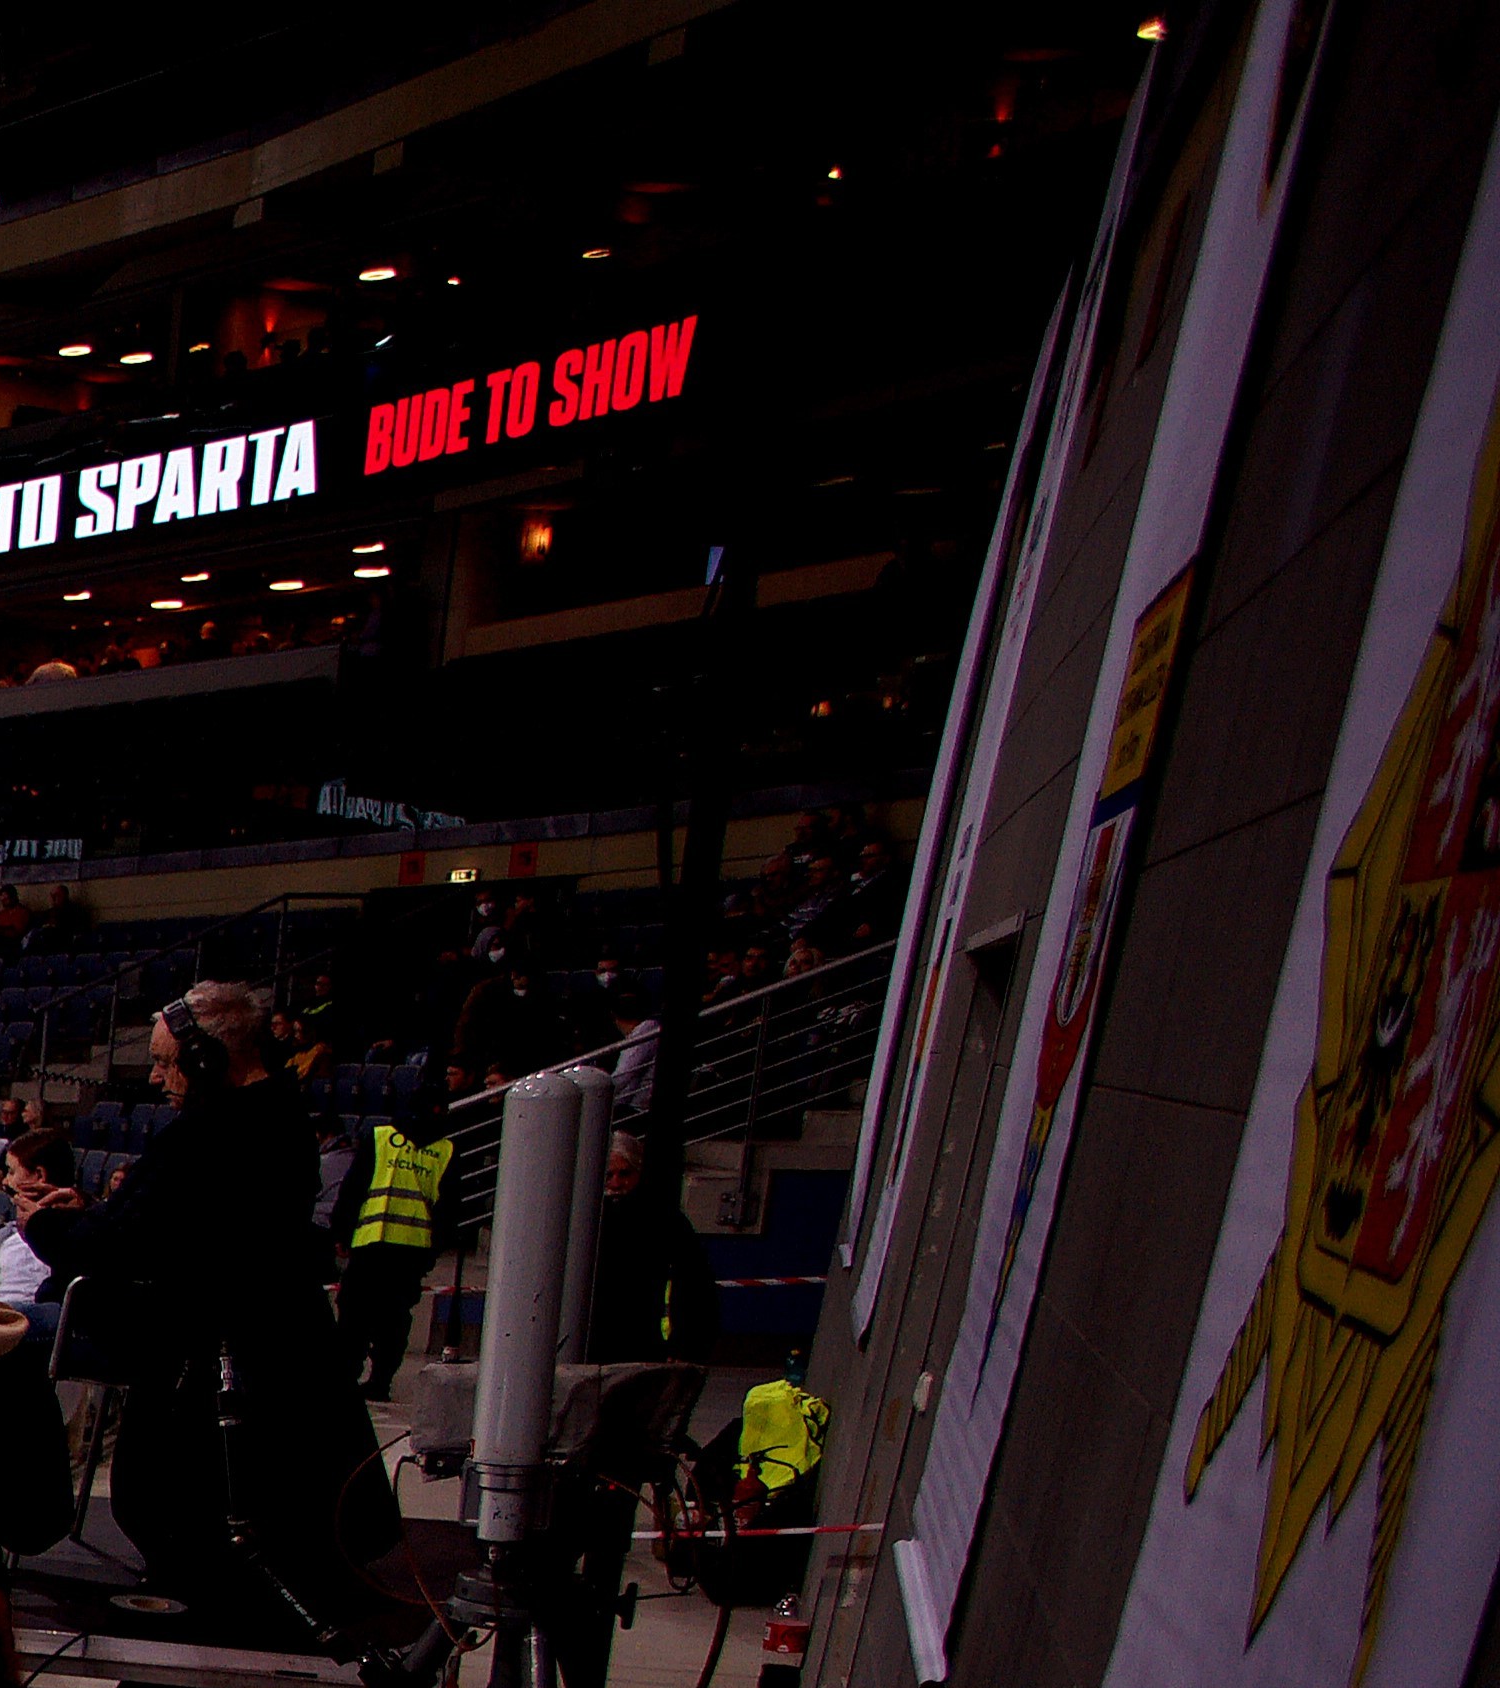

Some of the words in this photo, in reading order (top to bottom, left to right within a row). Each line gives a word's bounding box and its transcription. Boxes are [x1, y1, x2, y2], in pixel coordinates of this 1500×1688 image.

[364, 380, 476, 475] BUDE
[486, 361, 540, 443] TO
[549, 315, 698, 426] SHOW
[74, 418, 317, 540] SPARTA
